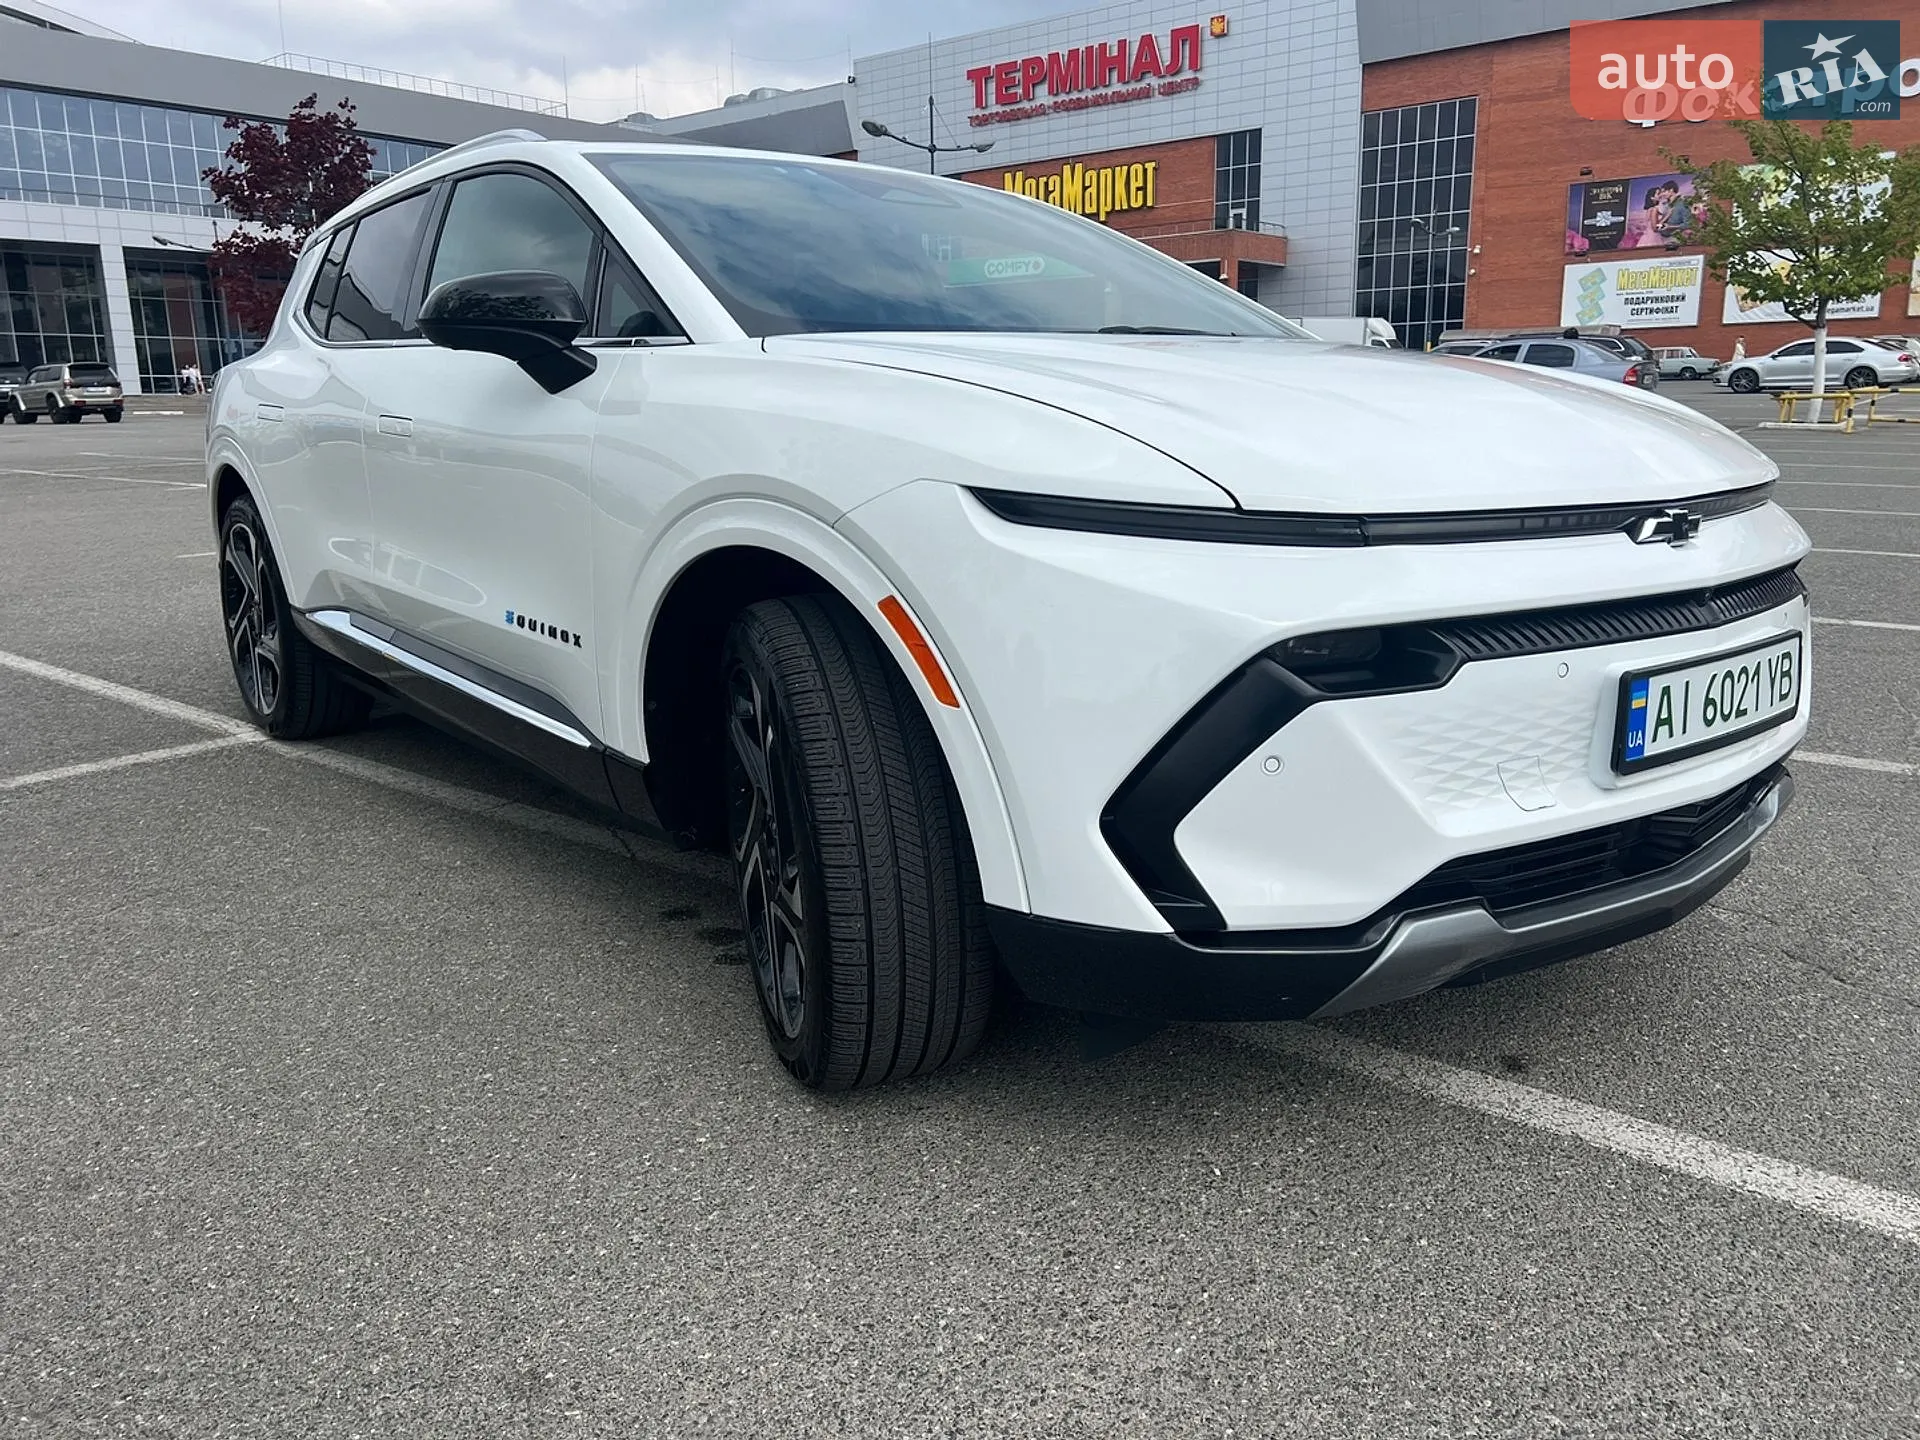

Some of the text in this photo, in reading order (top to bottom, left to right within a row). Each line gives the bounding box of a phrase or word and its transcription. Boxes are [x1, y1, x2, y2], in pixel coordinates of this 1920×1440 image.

[966, 23, 1202, 109] ТЕРМІНАЛ
[986, 260, 1032, 276] COMFY
[1616, 265, 1699, 292] МегаМаркет
[1624, 293, 1687, 306] ПОДАРУНКОВИЙ
[1630, 306, 1680, 316] СЕРТИФІКАТ
[504, 609, 583, 649] EQUINOX
[1651, 650, 1793, 744] AI 6021 YB
[1627, 729, 1644, 748] UA
